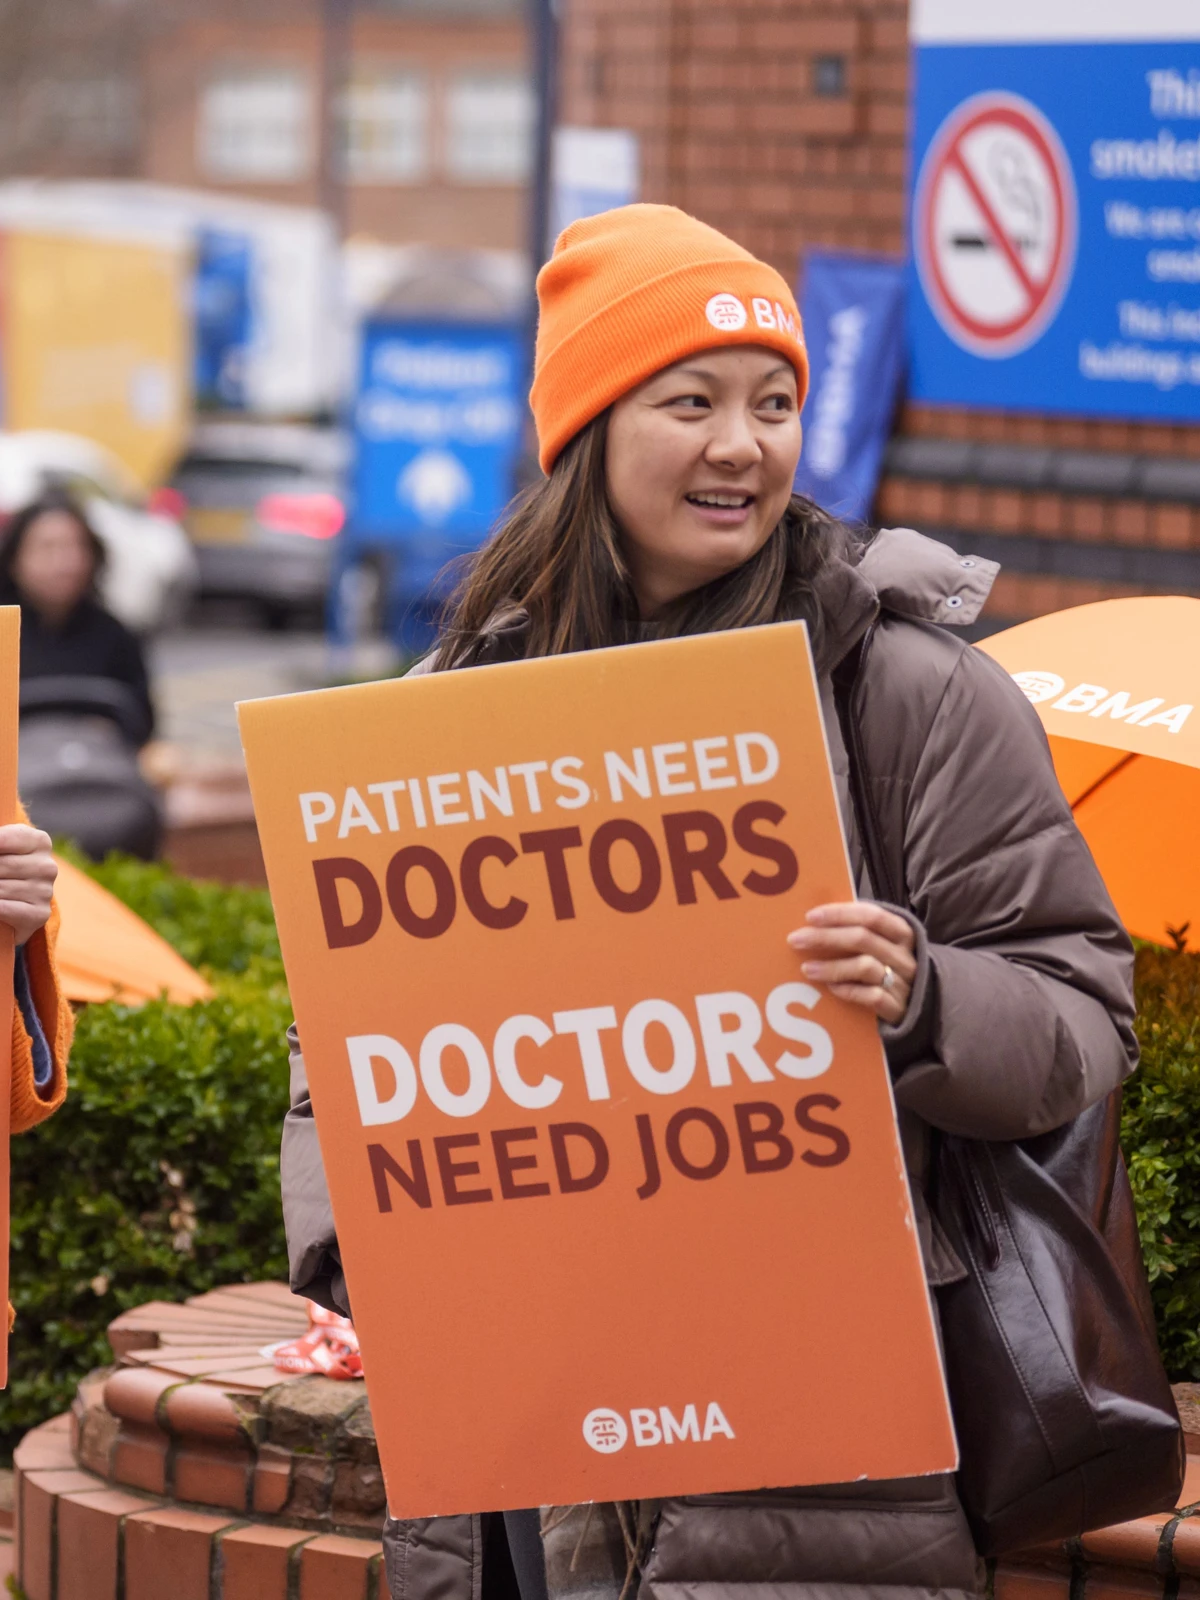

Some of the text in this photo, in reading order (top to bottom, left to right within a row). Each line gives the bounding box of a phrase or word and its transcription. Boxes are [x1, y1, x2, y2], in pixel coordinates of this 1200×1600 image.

[1145, 68, 1200, 117] Thi
[1090, 129, 1200, 180] smoke
[1050, 683, 1194, 733] BMA
[299, 731, 780, 843] PATIENTS NEED
[312, 799, 799, 949] DOCTORS
[345, 982, 835, 1127] DOCTORS
[366, 1092, 852, 1213] NEED JOBS
[632, 1401, 735, 1447] BMA
